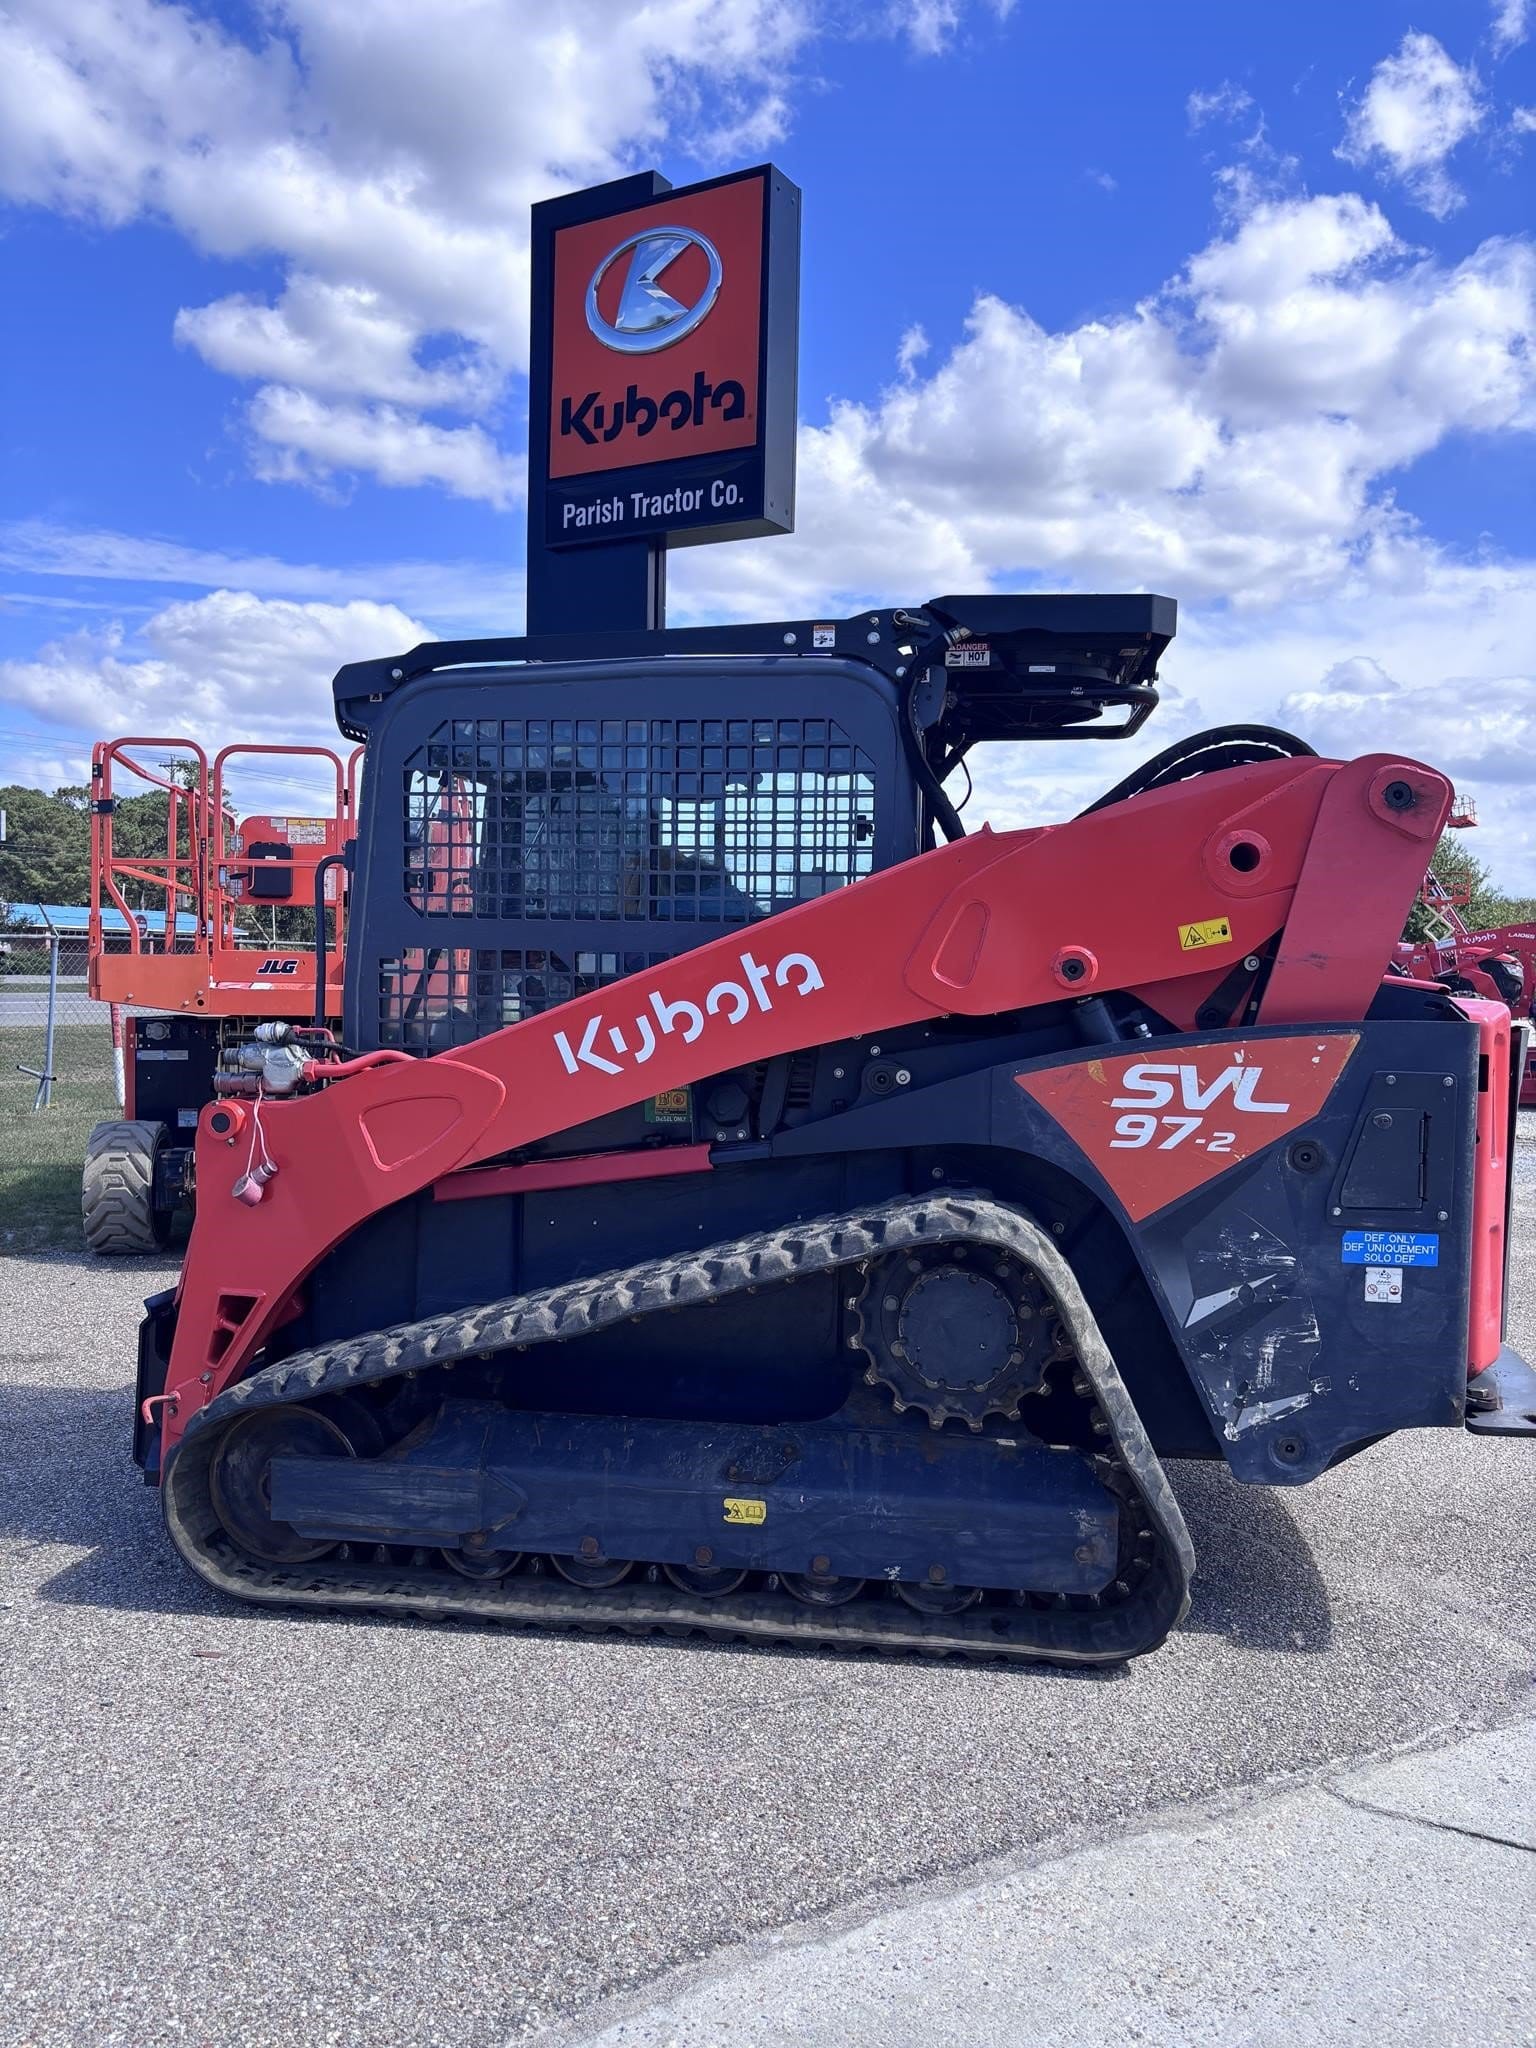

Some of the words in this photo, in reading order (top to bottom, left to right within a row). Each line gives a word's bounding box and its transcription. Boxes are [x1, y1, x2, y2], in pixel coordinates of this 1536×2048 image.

[560, 370, 746, 445] Kubota
[563, 497, 624, 529] Parish
[630, 487, 704, 519] Tractor
[710, 479, 745, 508] Co.
[956, 643, 988, 651] DANGER
[968, 651, 986, 661] HOT
[1462, 933, 1497, 944] Kubota
[256, 959, 299, 974] JLG
[553, 952, 825, 1076] Kubota
[1110, 1063, 1291, 1113] SVL
[1109, 1113, 1237, 1153] 97-2
[1364, 1233, 1385, 1242] DEF
[1388, 1234, 1416, 1244] ONLY
[1344, 1242, 1364, 1251] DEF
[1367, 1244, 1436, 1254] UNIQUEMENT
[1364, 1253, 1391, 1262] SOLO
[1395, 1254, 1415, 1263] DEF
